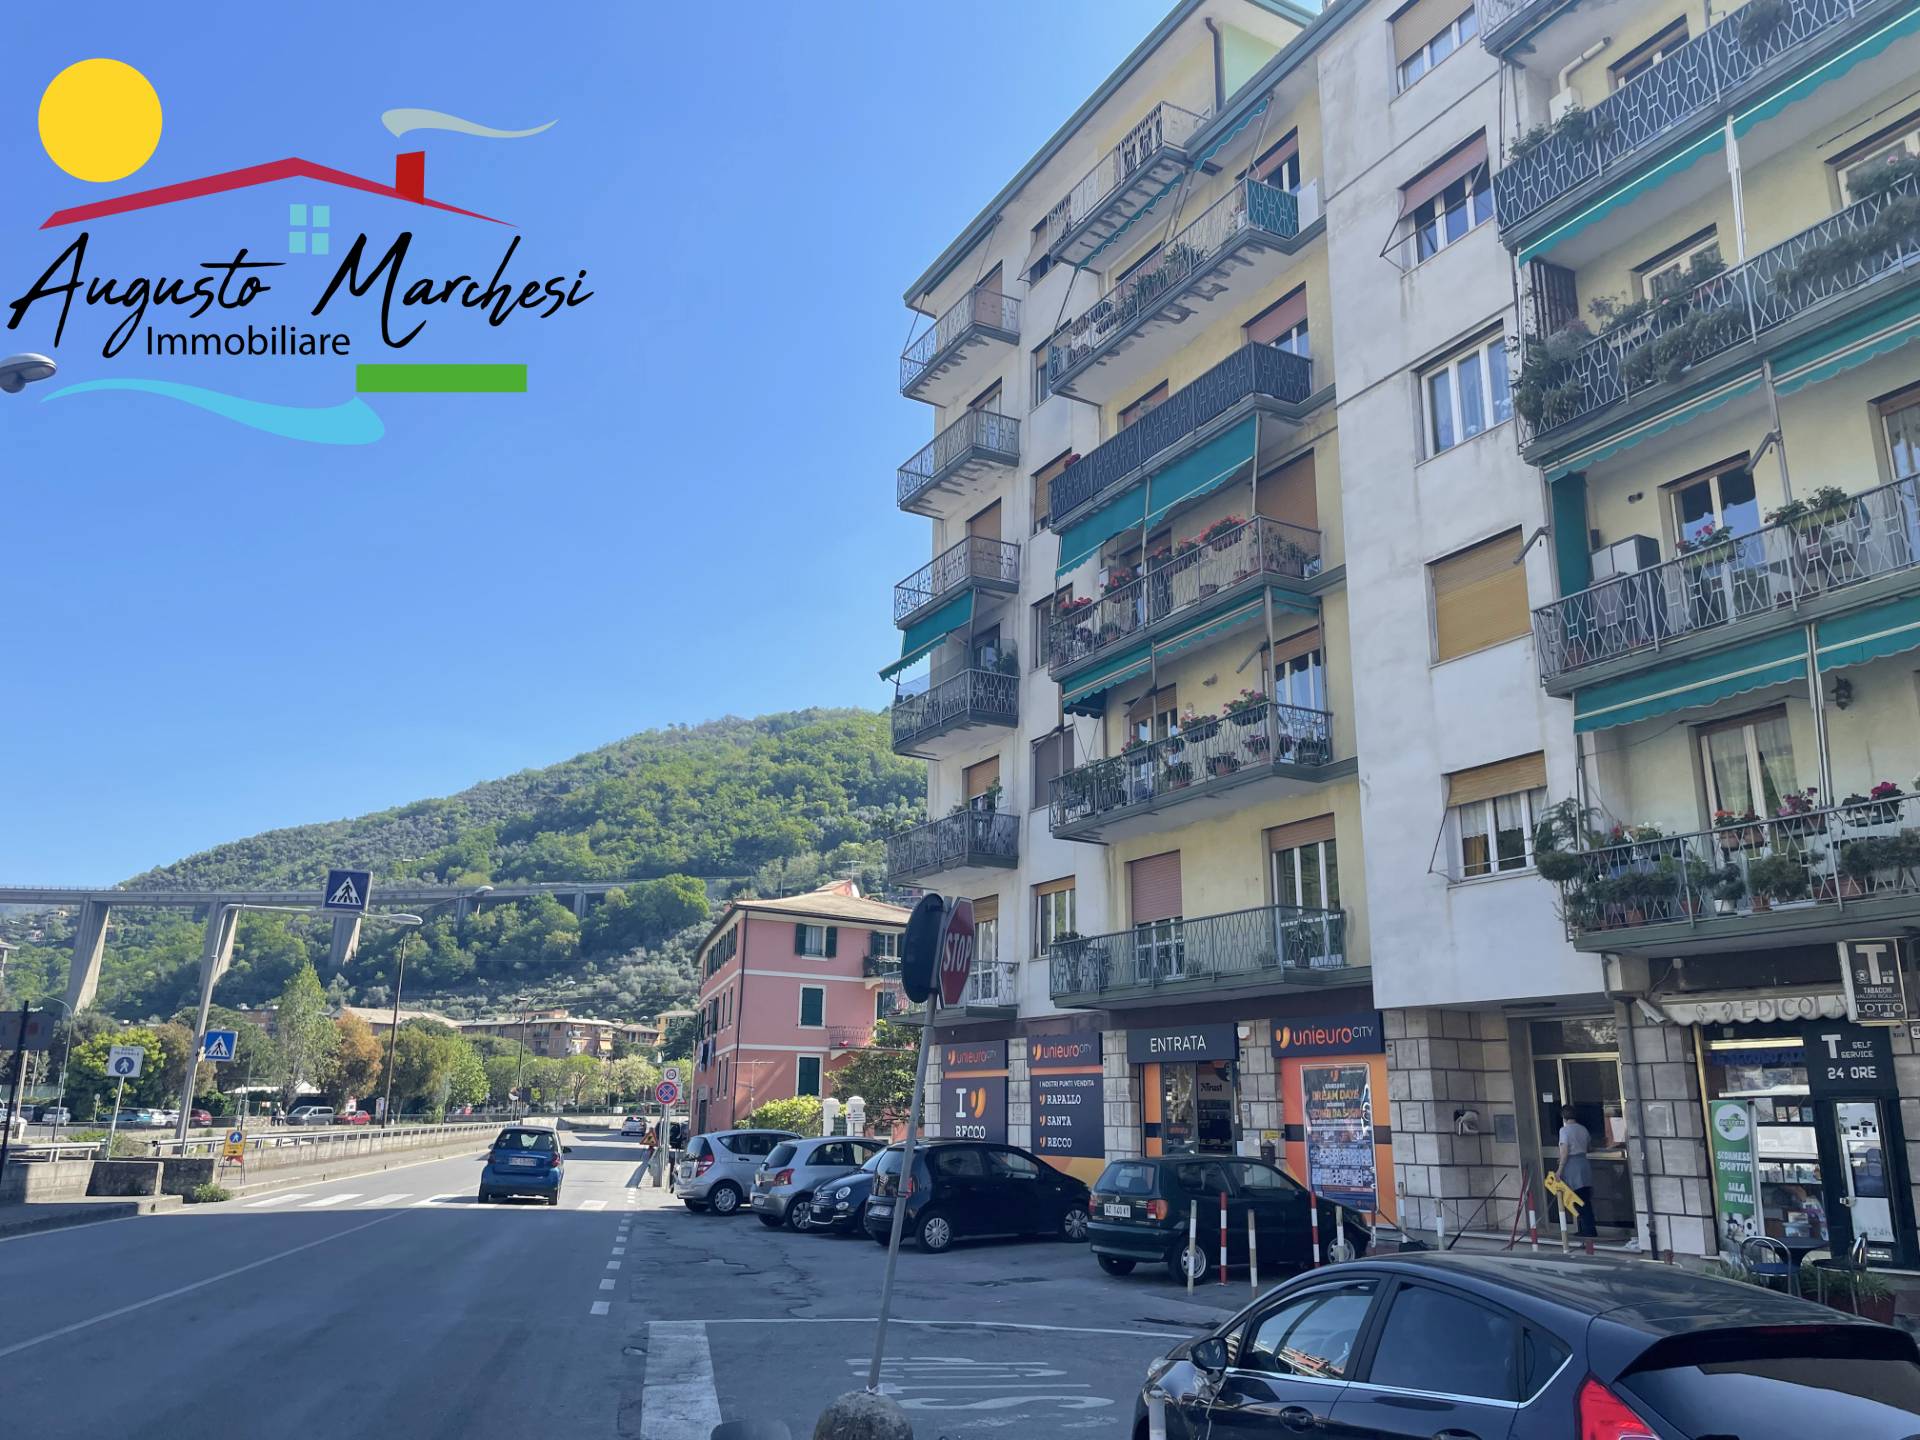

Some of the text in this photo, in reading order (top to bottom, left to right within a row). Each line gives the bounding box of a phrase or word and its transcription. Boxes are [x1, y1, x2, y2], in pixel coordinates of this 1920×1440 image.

[943, 932, 972, 973] STOP
[1855, 944, 1887, 985] T
[1741, 995, 1846, 1019] EDICOLA
[1856, 1003, 1904, 1013] LOTTO
[1292, 1024, 1374, 1047] unieuro CITY
[1150, 1034, 1206, 1054] ENTRATA
[1821, 1034, 1842, 1059] T
[1851, 1041, 1873, 1049] SELF
[1043, 1043, 1079, 1060] unieuro
[1840, 1051, 1874, 1059] SERVICE
[1827, 1066, 1878, 1080] 24 ORE
[1042, 1080, 1059, 1088] NOSTRI
[1074, 1079, 1095, 1087] VENDITA
[955, 1088, 967, 1118] I
[1046, 1094, 1081, 1105] RAPALLO
[1046, 1115, 1072, 1127] SANTA
[955, 1125, 986, 1139] RECCO
[1047, 1137, 1072, 1148] RECCO
[1717, 1151, 1751, 1161] SCOMMESS
